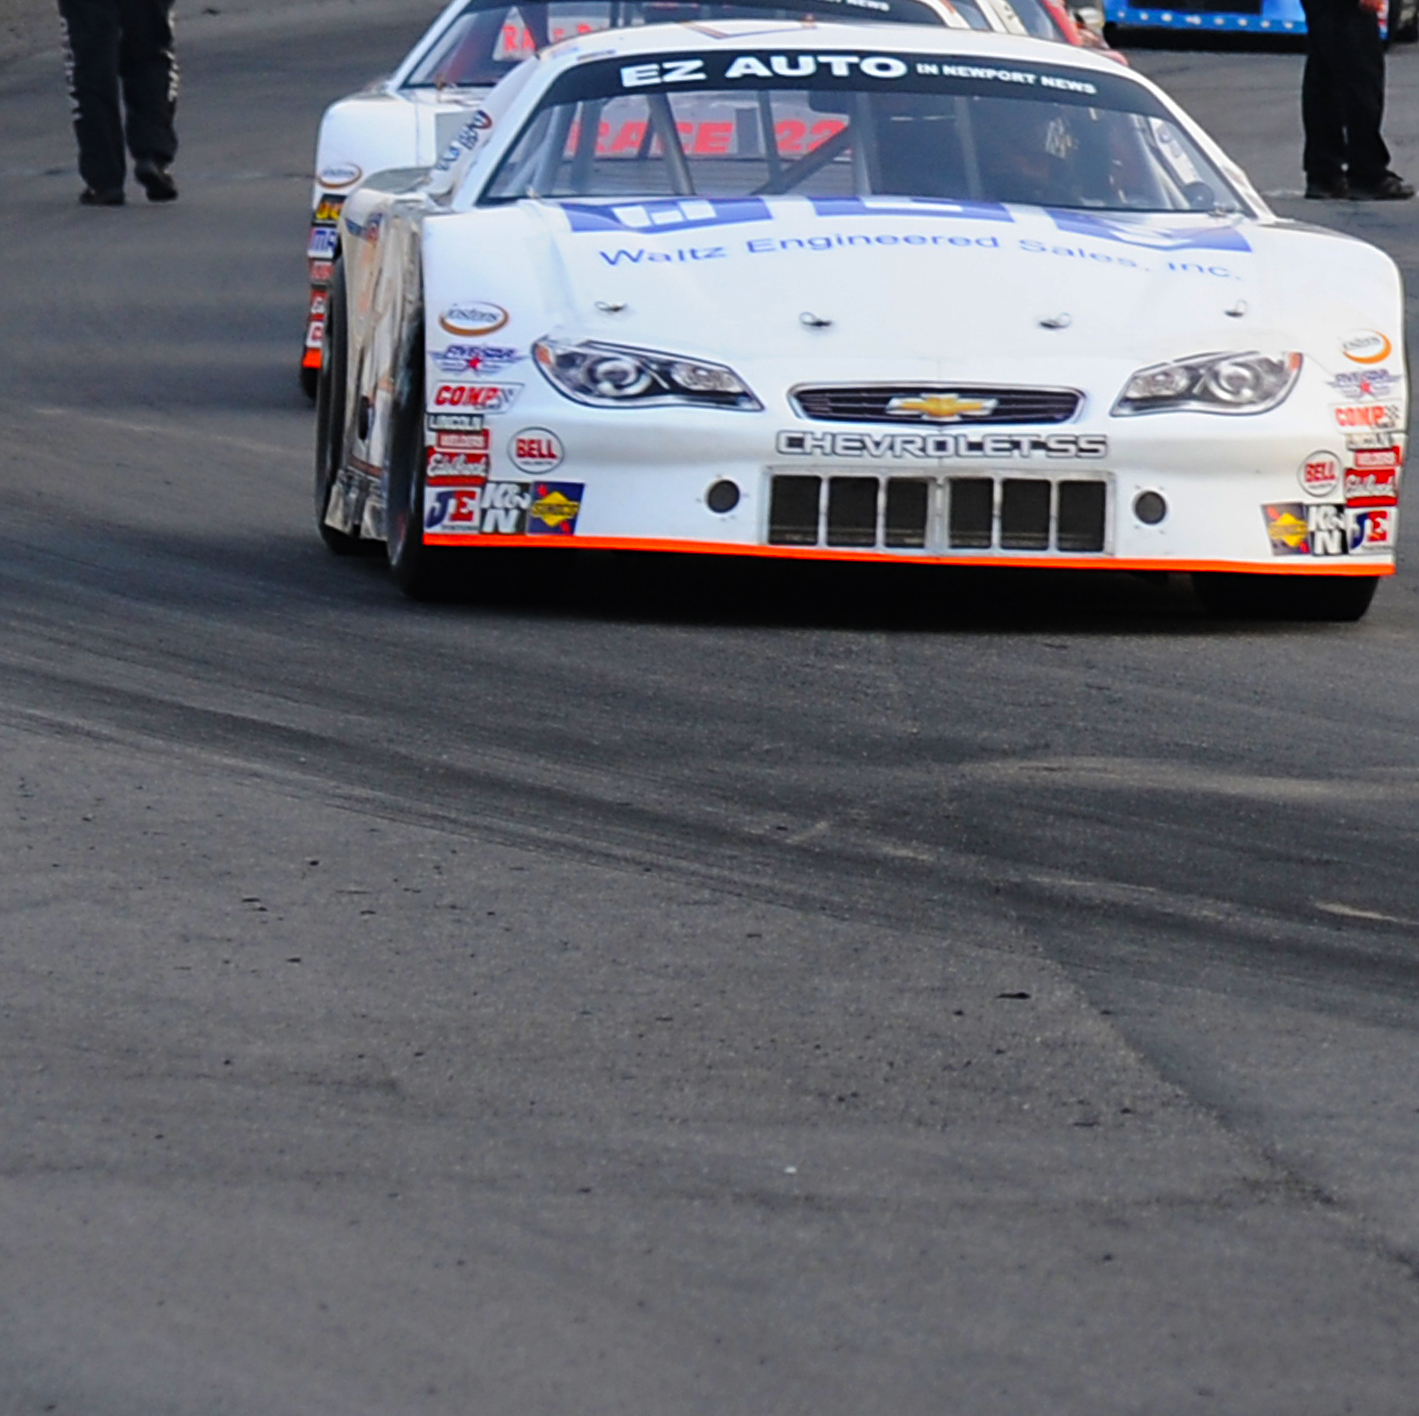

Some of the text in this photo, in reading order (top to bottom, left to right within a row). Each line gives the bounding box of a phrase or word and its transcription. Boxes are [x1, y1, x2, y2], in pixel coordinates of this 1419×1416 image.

[621, 55, 1097, 95] EZ AUTO IN NEWPORT NEWS
[599, 245, 726, 266] Waltz
[746, 233, 999, 253] Engineered
[435, 386, 501, 406] COMP
[516, 438, 558, 459] BELL
[776, 430, 1108, 459] CHEVROLET SS
[1305, 462, 1336, 483] BELL
[426, 489, 477, 529] JE
[1350, 510, 1389, 550] JE
